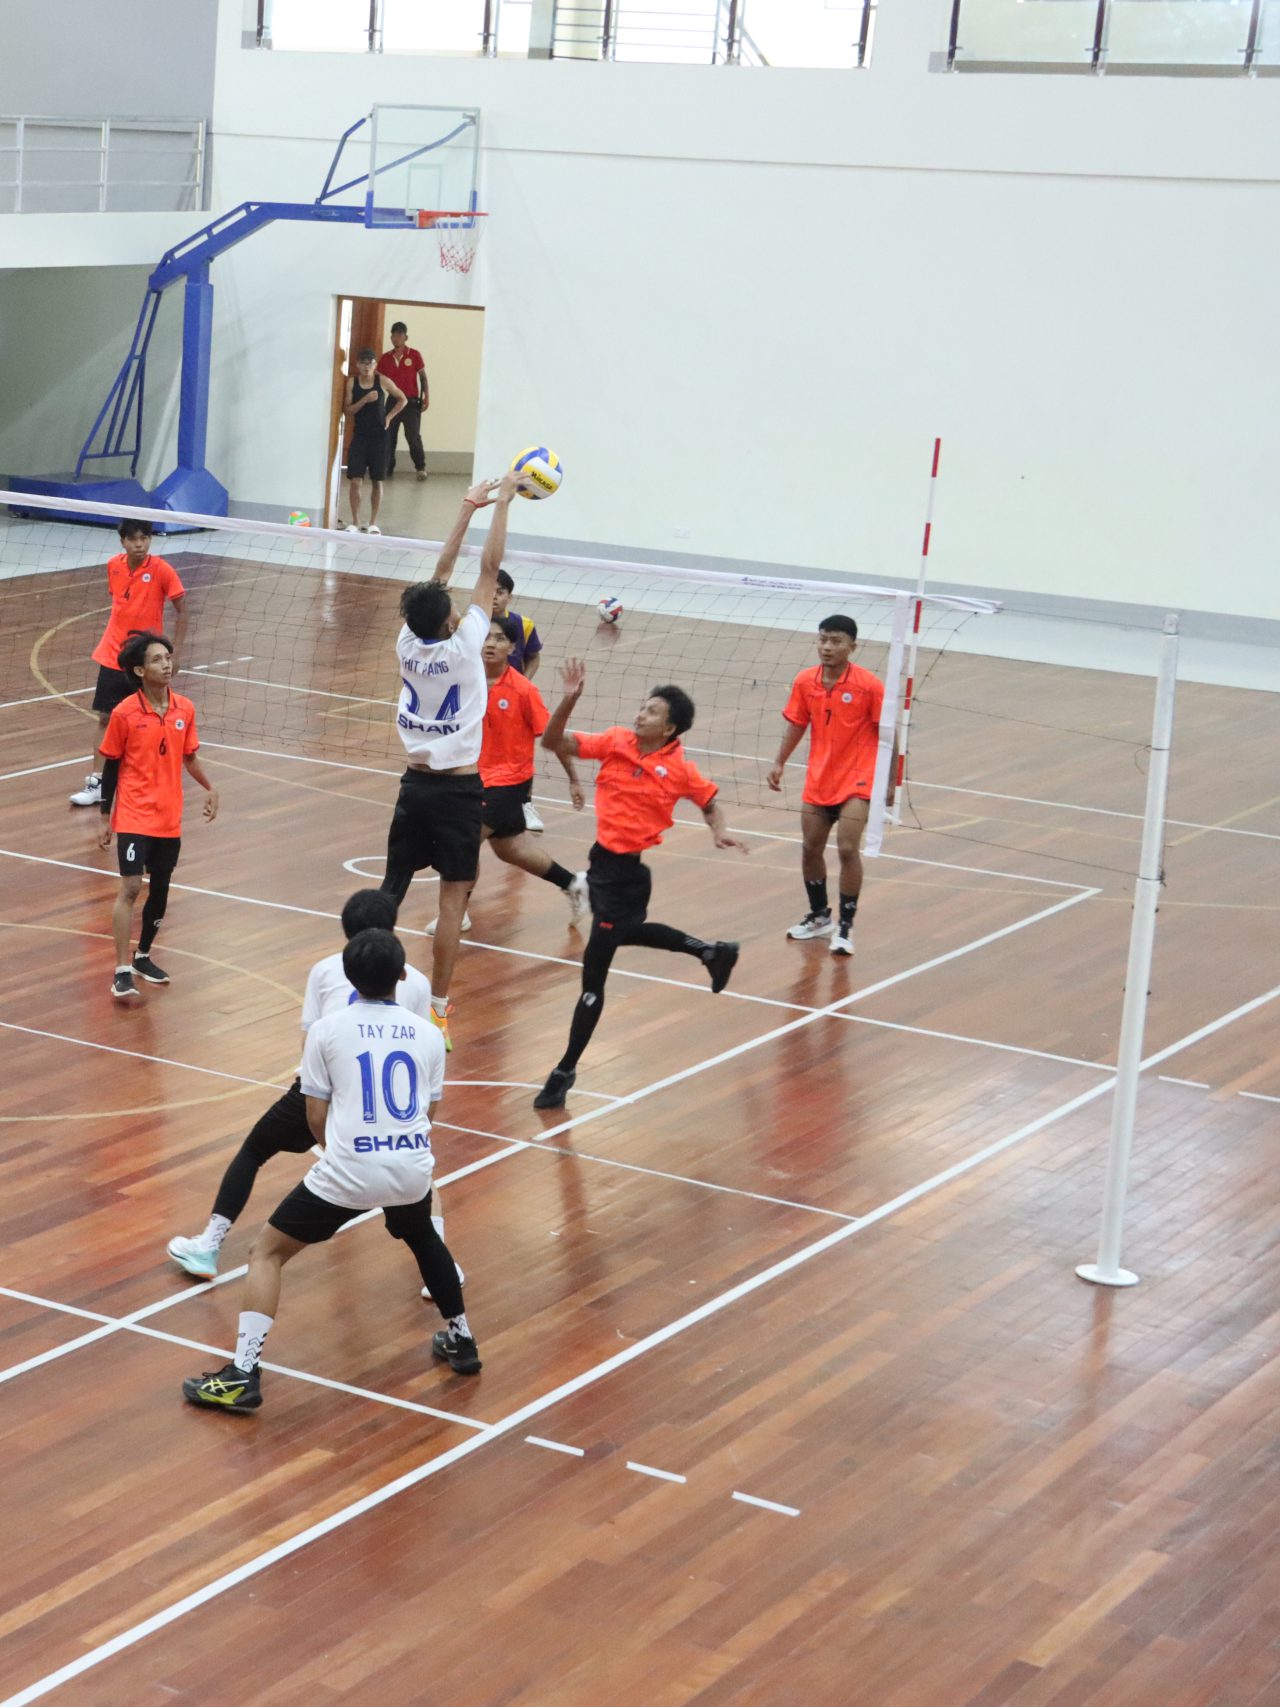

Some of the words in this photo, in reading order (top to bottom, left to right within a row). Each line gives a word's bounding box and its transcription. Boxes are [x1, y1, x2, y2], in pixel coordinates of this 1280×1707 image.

[398, 714, 460, 735] SHAN
[159, 738, 167, 756] 6
[126, 842, 136, 862] 6
[358, 1024, 384, 1039] TAY
[391, 1025, 416, 1041] ZAR
[356, 1050, 418, 1124] 10
[353, 1133, 430, 1153] SHAN
